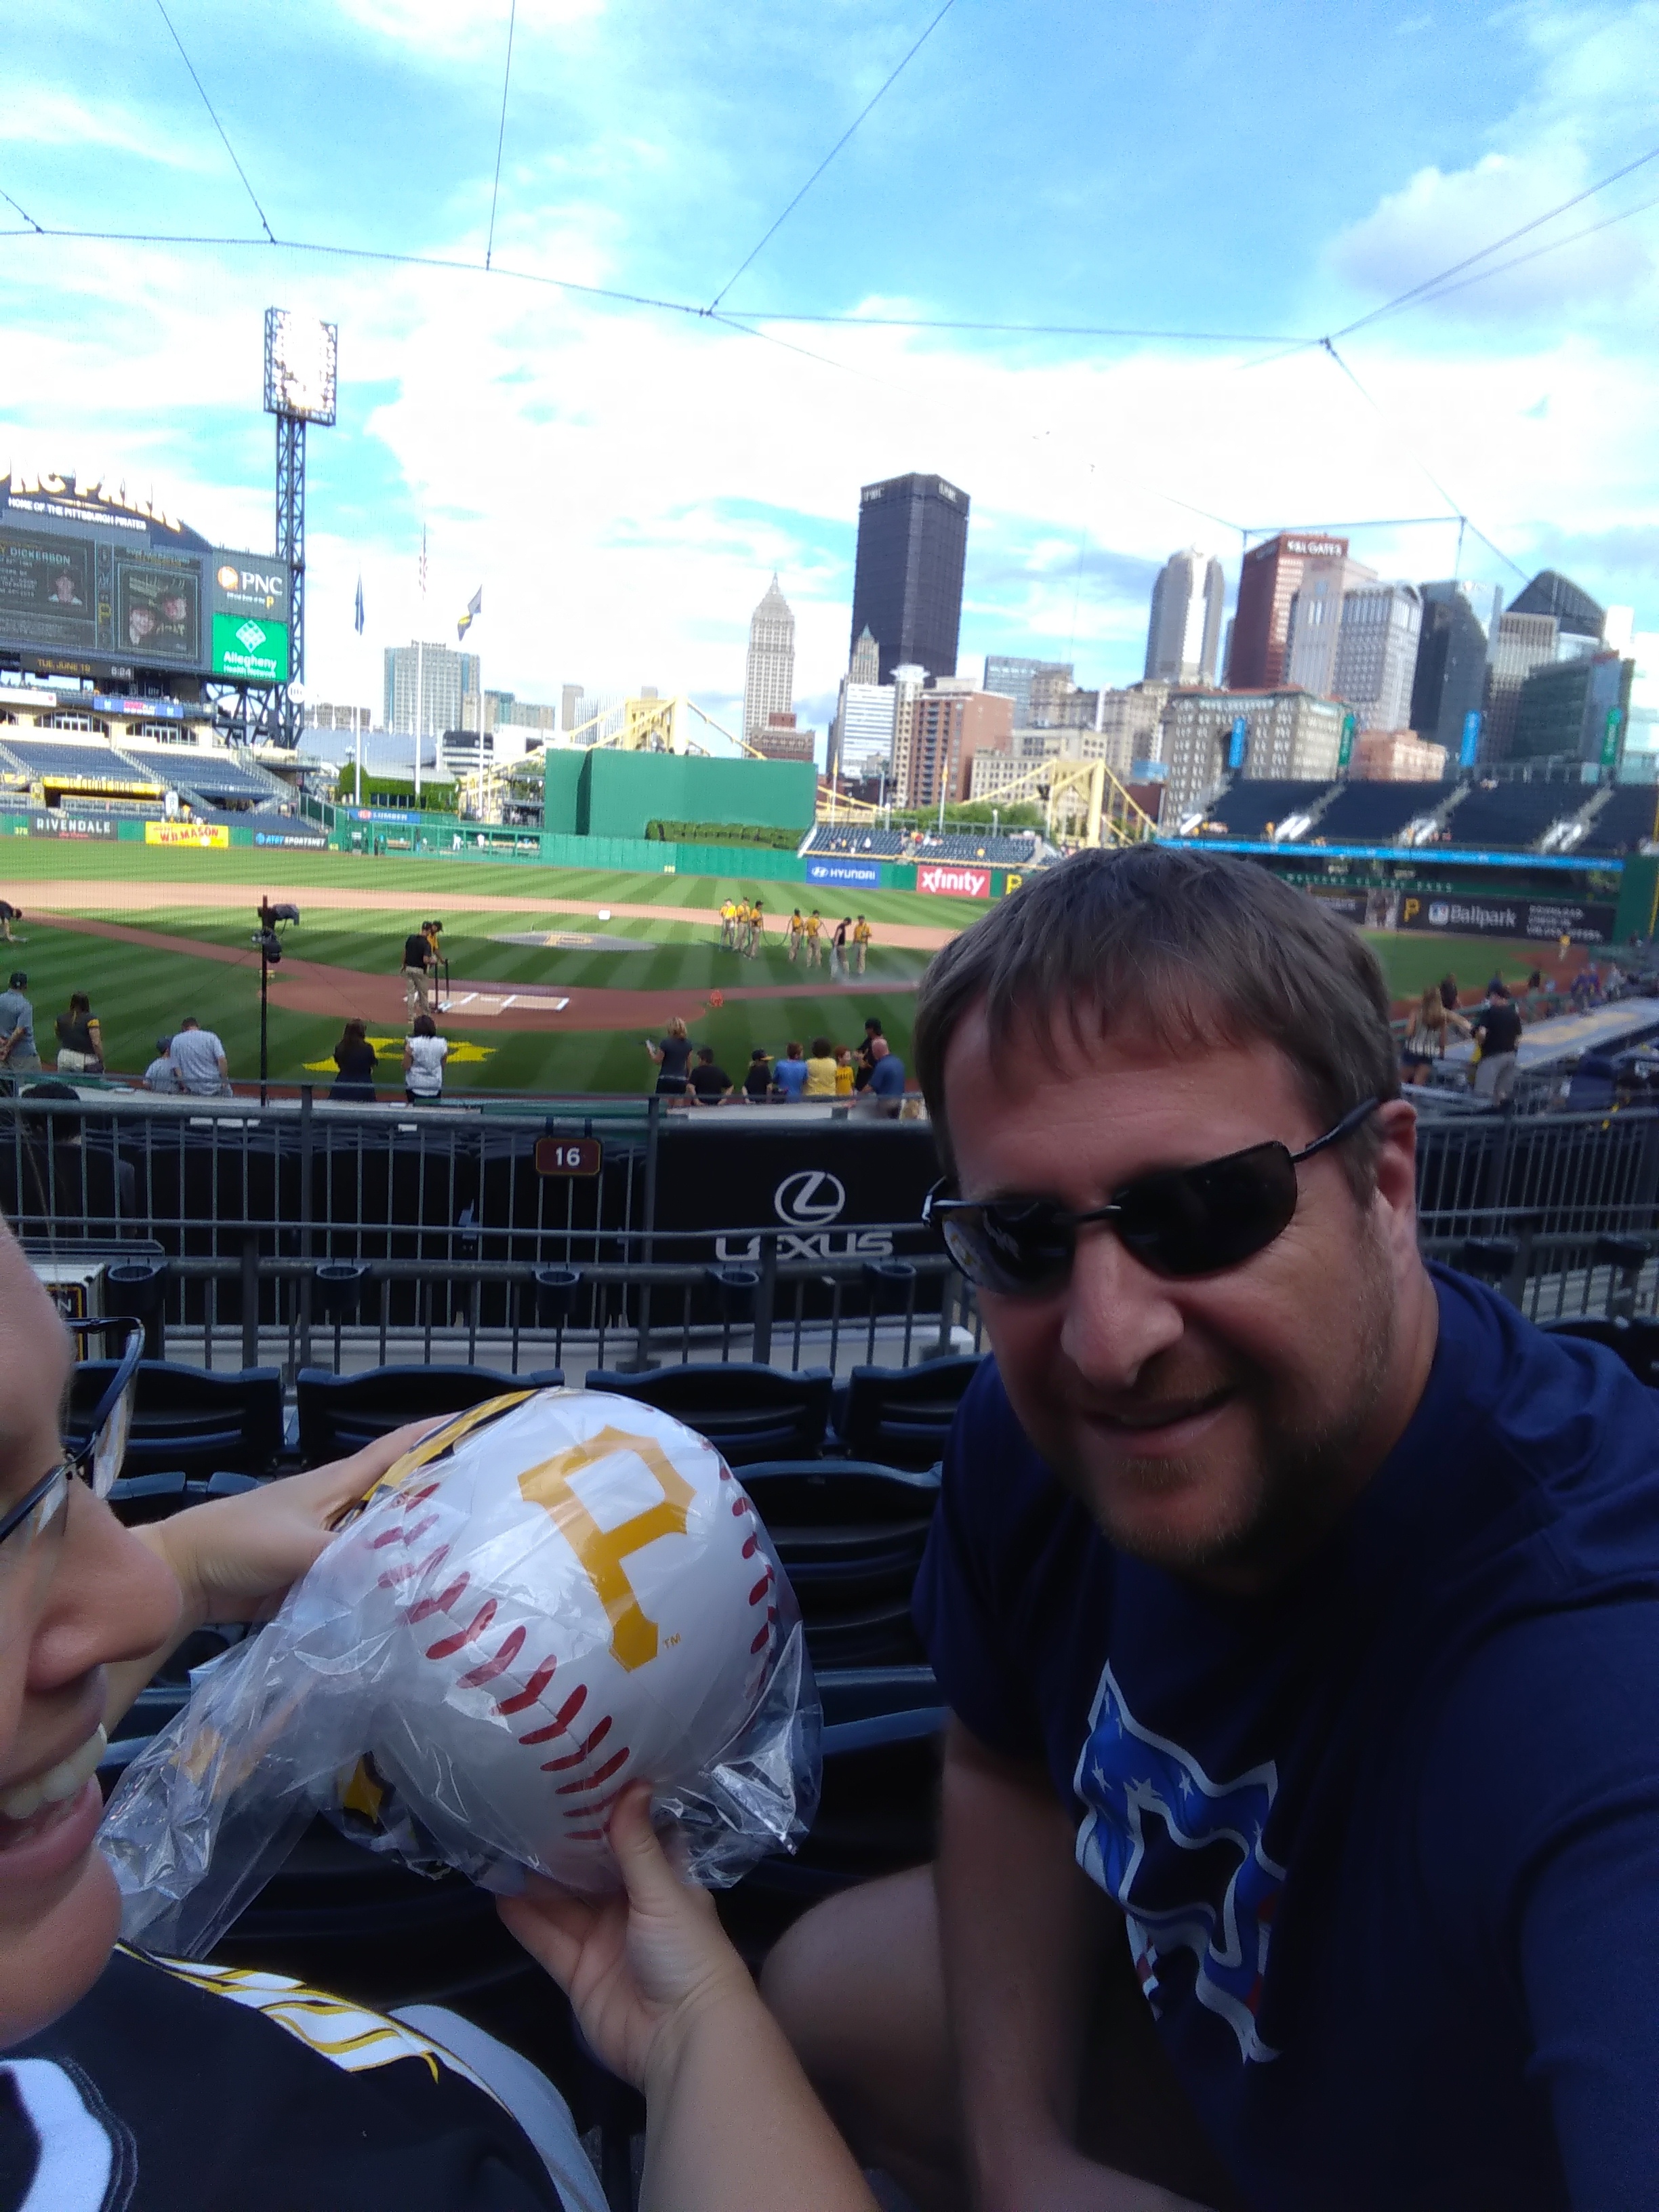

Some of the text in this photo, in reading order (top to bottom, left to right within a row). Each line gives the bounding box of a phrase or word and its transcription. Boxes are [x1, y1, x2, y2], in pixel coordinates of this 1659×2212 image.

[8, 496, 33, 510] HOME
[47, 503, 64, 516] THE
[64, 506, 114, 527] PITTSBURGH
[115, 514, 146, 531] PIRATES
[241, 571, 283, 596] PNC
[224, 651, 277, 670] Allegheny
[37, 817, 110, 834] RIVENDALE
[284, 836, 326, 847] SPORTSNET
[830, 869, 876, 880] HYUNDAI
[922, 868, 985, 897] xfinity
[1006, 874, 1023, 895] P
[1404, 898, 1420, 922] P
[1451, 904, 1517, 928] Ballpark
[555, 1147, 580, 1167] 16
[517, 1424, 698, 1672] P
[663, 1634, 682, 1649] TM
